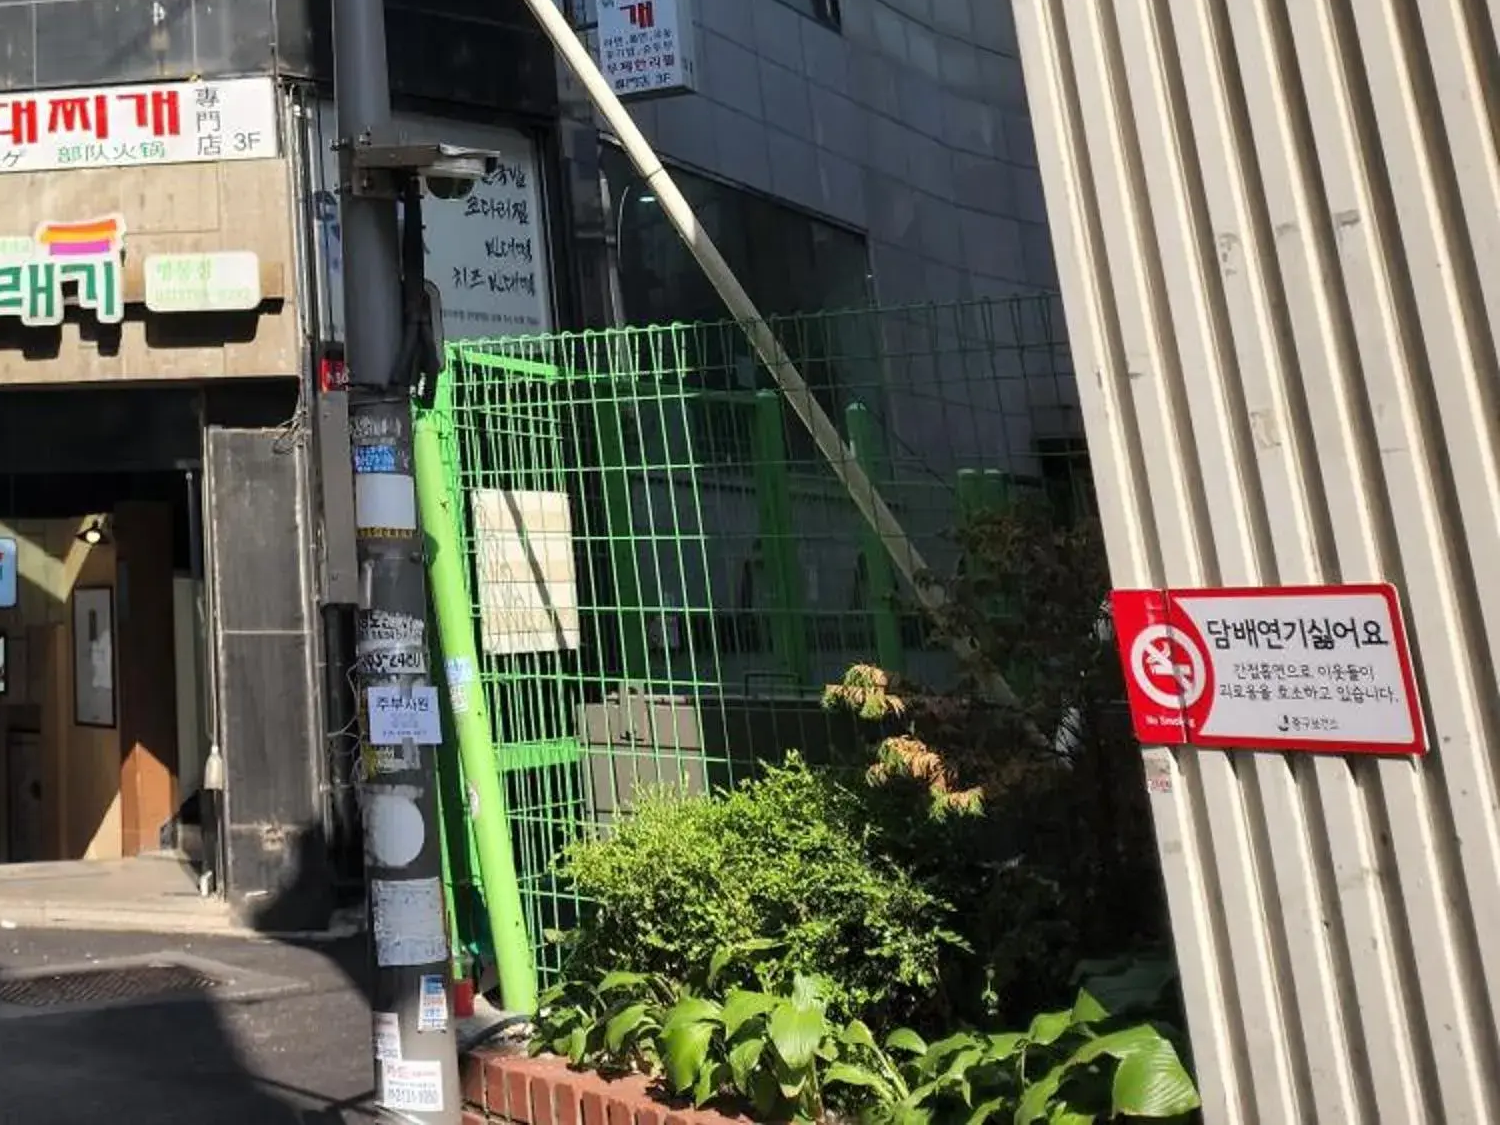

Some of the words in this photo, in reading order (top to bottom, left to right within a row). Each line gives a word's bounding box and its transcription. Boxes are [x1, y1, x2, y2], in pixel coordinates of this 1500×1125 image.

[57, 141, 167, 163] 部队火锅
[233, 133, 261, 152] 3F
[1206, 617, 1389, 651] 담배연기싫어요
[1234, 663, 1311, 681] 간접흡연으로
[1318, 664, 1375, 681] 이웃들이
[1219, 684, 1271, 703] 괴로움을
[1278, 685, 1333, 701] 호소하고
